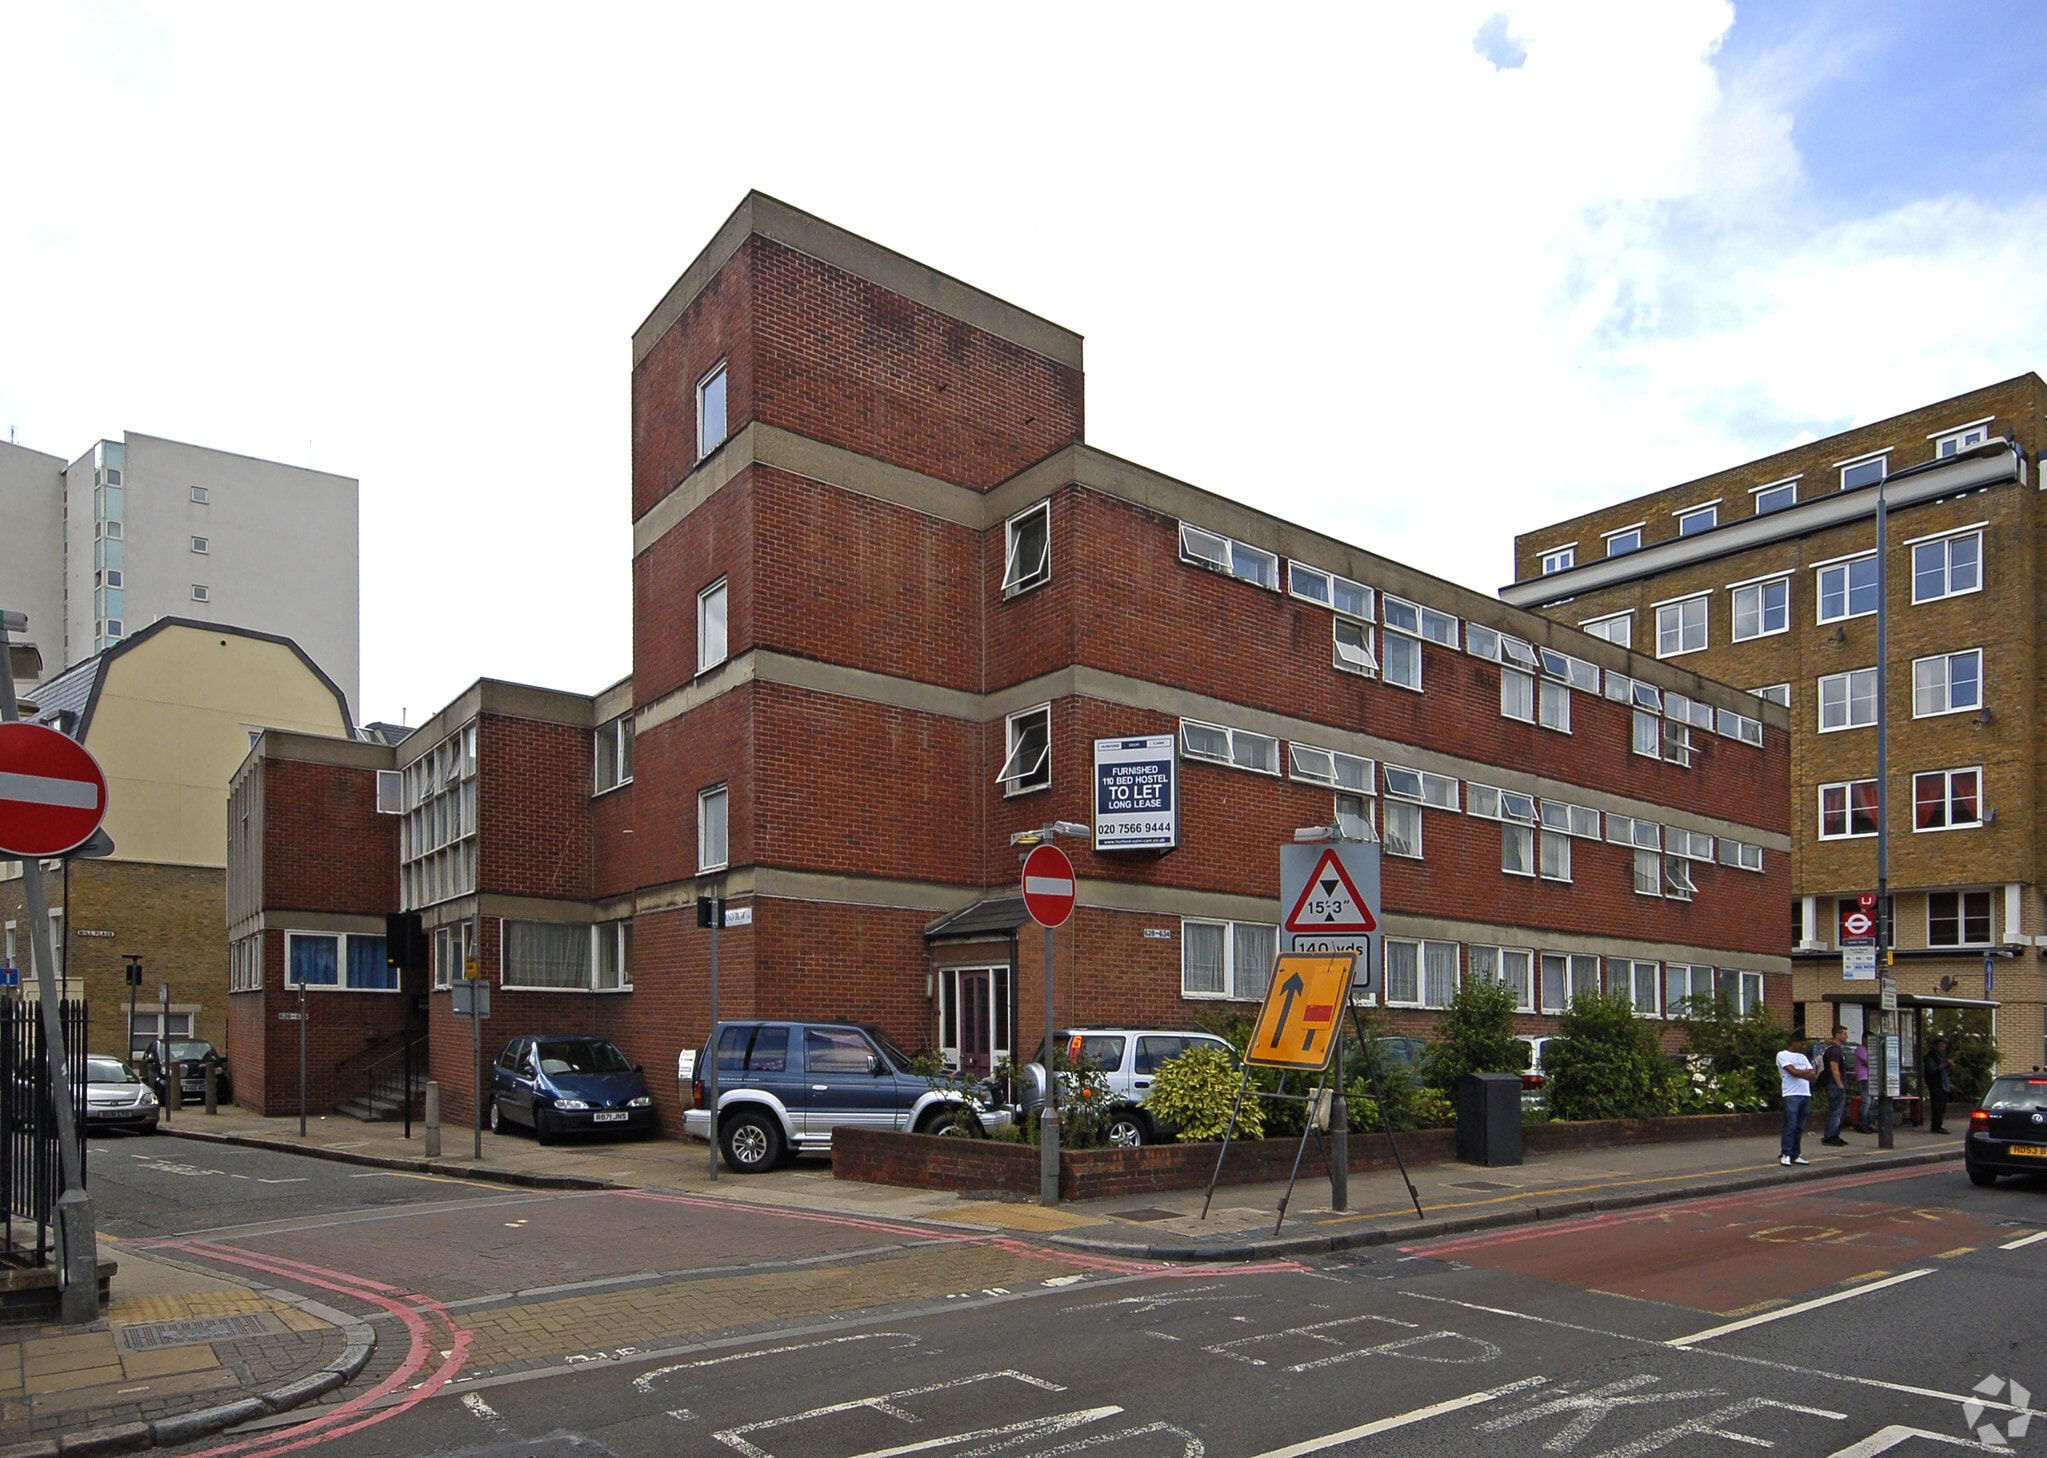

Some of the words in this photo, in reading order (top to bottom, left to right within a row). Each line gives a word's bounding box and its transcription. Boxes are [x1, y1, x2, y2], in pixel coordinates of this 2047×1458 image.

[1112, 765, 1158, 776] FURNISHED
[1102, 777, 1114, 785] 110
[1116, 776, 1133, 785] BED
[1135, 774, 1168, 784] HOSTEL
[1108, 786, 1129, 800] TO
[1133, 784, 1162, 799] LET
[1108, 800, 1132, 809] LONG
[1133, 799, 1162, 808] LEASE
[1098, 825, 1115, 835] 020
[1119, 823, 1142, 834] 7566
[1145, 822, 1171, 833] 9444
[1299, 942, 1329, 952] 140
